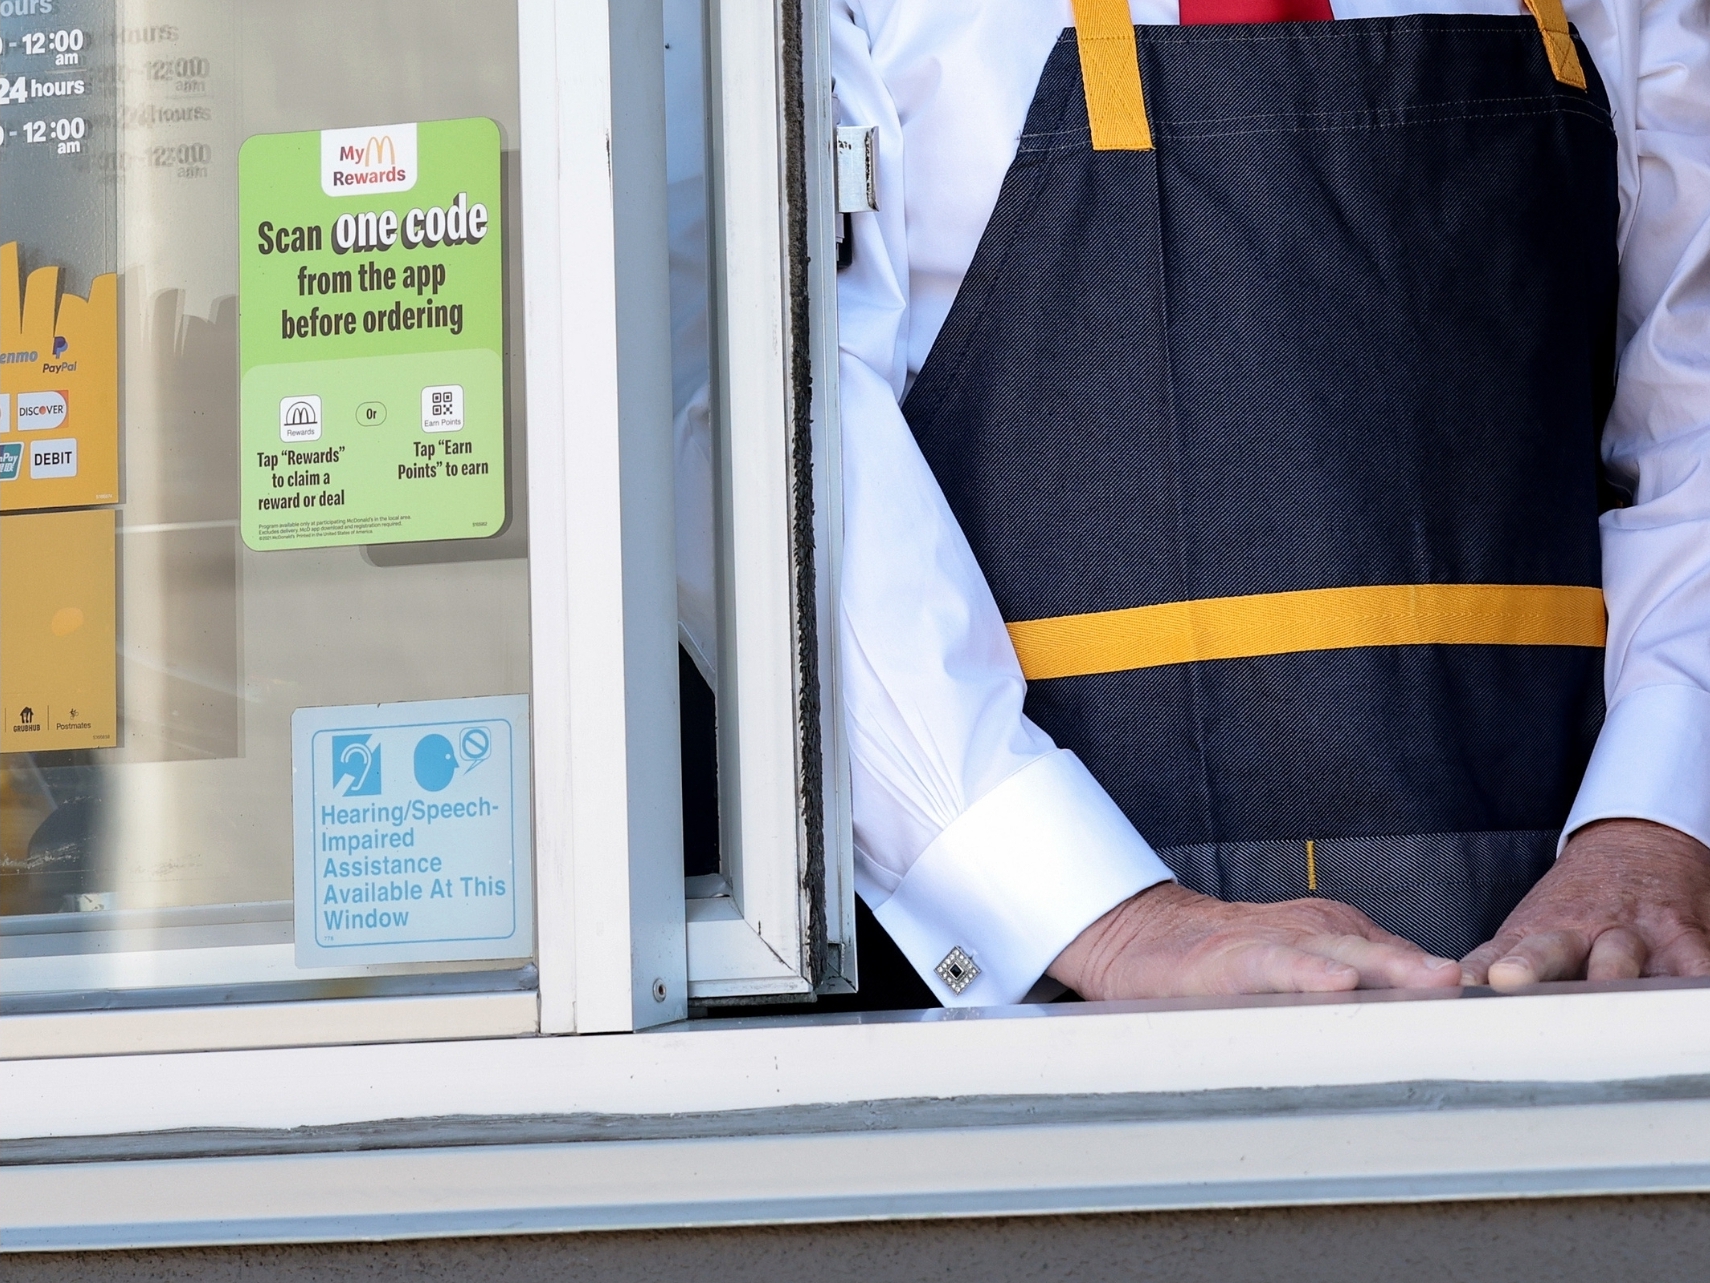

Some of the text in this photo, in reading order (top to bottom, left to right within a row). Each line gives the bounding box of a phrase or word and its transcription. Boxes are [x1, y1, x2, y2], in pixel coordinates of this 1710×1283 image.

[22, 29, 83, 54] 12:00
[55, 53, 78, 65] am
[0, 77, 84, 104] 24 hours
[23, 117, 85, 143] 12:00
[57, 141, 80, 154] am
[340, 146, 364, 164] My
[334, 167, 406, 186] Rewards
[258, 192, 488, 255] Scan one code
[298, 261, 446, 296] from the app
[281, 299, 463, 339] before ordering
[42, 361, 77, 374] PayPal
[19, 405, 64, 417] DISCOVER
[366, 408, 377, 419] Or
[424, 418, 461, 427] Earn Points
[287, 428, 315, 437] Rewards
[34, 451, 72, 466] DEBIT
[413, 442, 435, 460] Tap
[257, 452, 278, 471] Tap
[445, 462, 458, 477] to
[461, 462, 488, 476] earn
[272, 470, 330, 488] to claim a
[258, 489, 344, 510] reward or deal
[13, 724, 41, 733] GRUBHUB
[56, 722, 91, 731] Postmates
[321, 796, 498, 826] Hearing/Speech-
[322, 827, 414, 856] Impaired
[323, 855, 442, 879] Assistance
[324, 875, 506, 905] Available At This
[324, 907, 409, 931] Window
